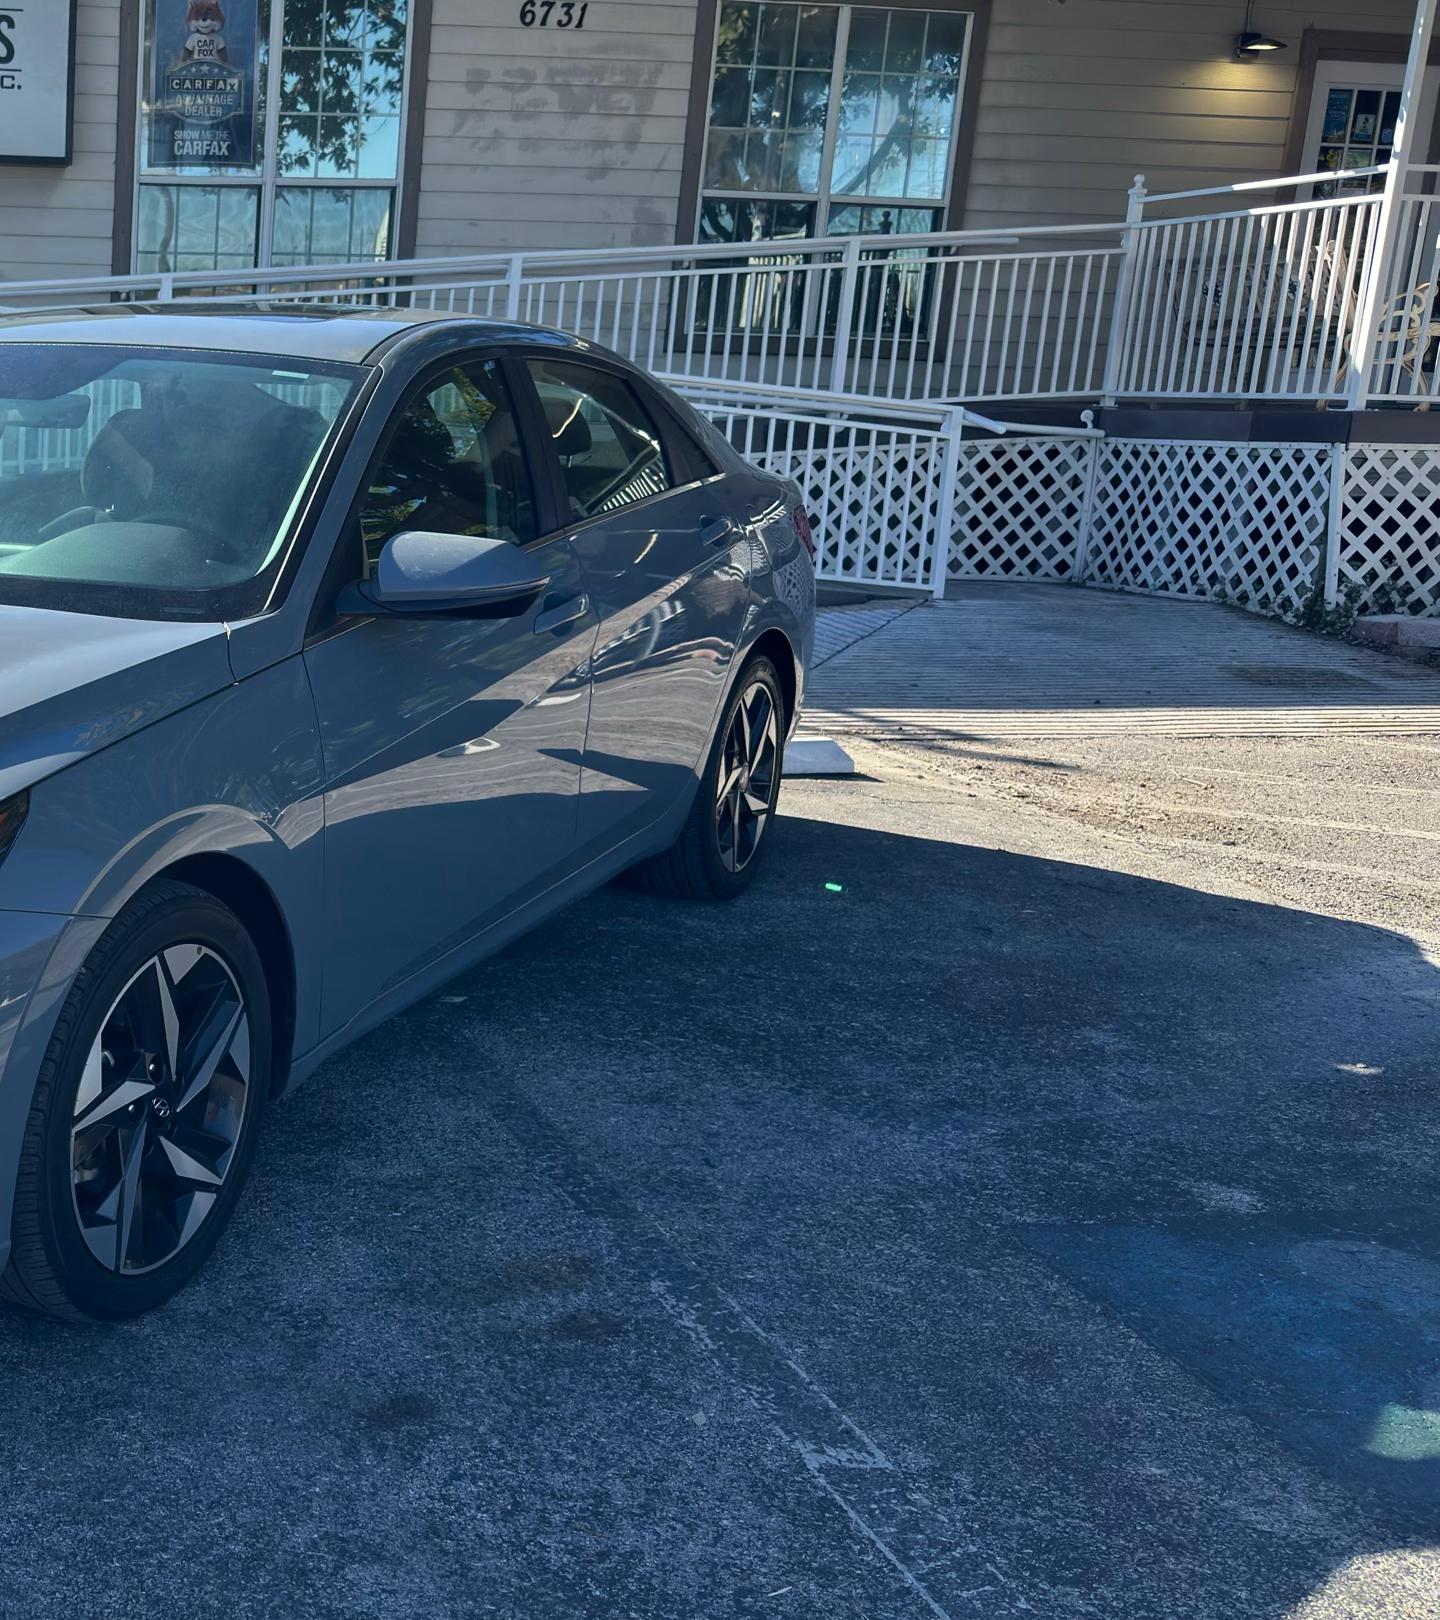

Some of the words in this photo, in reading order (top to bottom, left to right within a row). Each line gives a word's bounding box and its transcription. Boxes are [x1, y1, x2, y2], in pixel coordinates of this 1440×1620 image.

[519, 0, 588, 28] 6731
[196, 39, 215, 49] CAR
[197, 49, 214, 57] FOX
[171, 79, 238, 92] CARFAX
[185, 105, 223, 117] DEALER
[174, 130, 200, 140] SHOW
[174, 141, 229, 156] CARFAX
